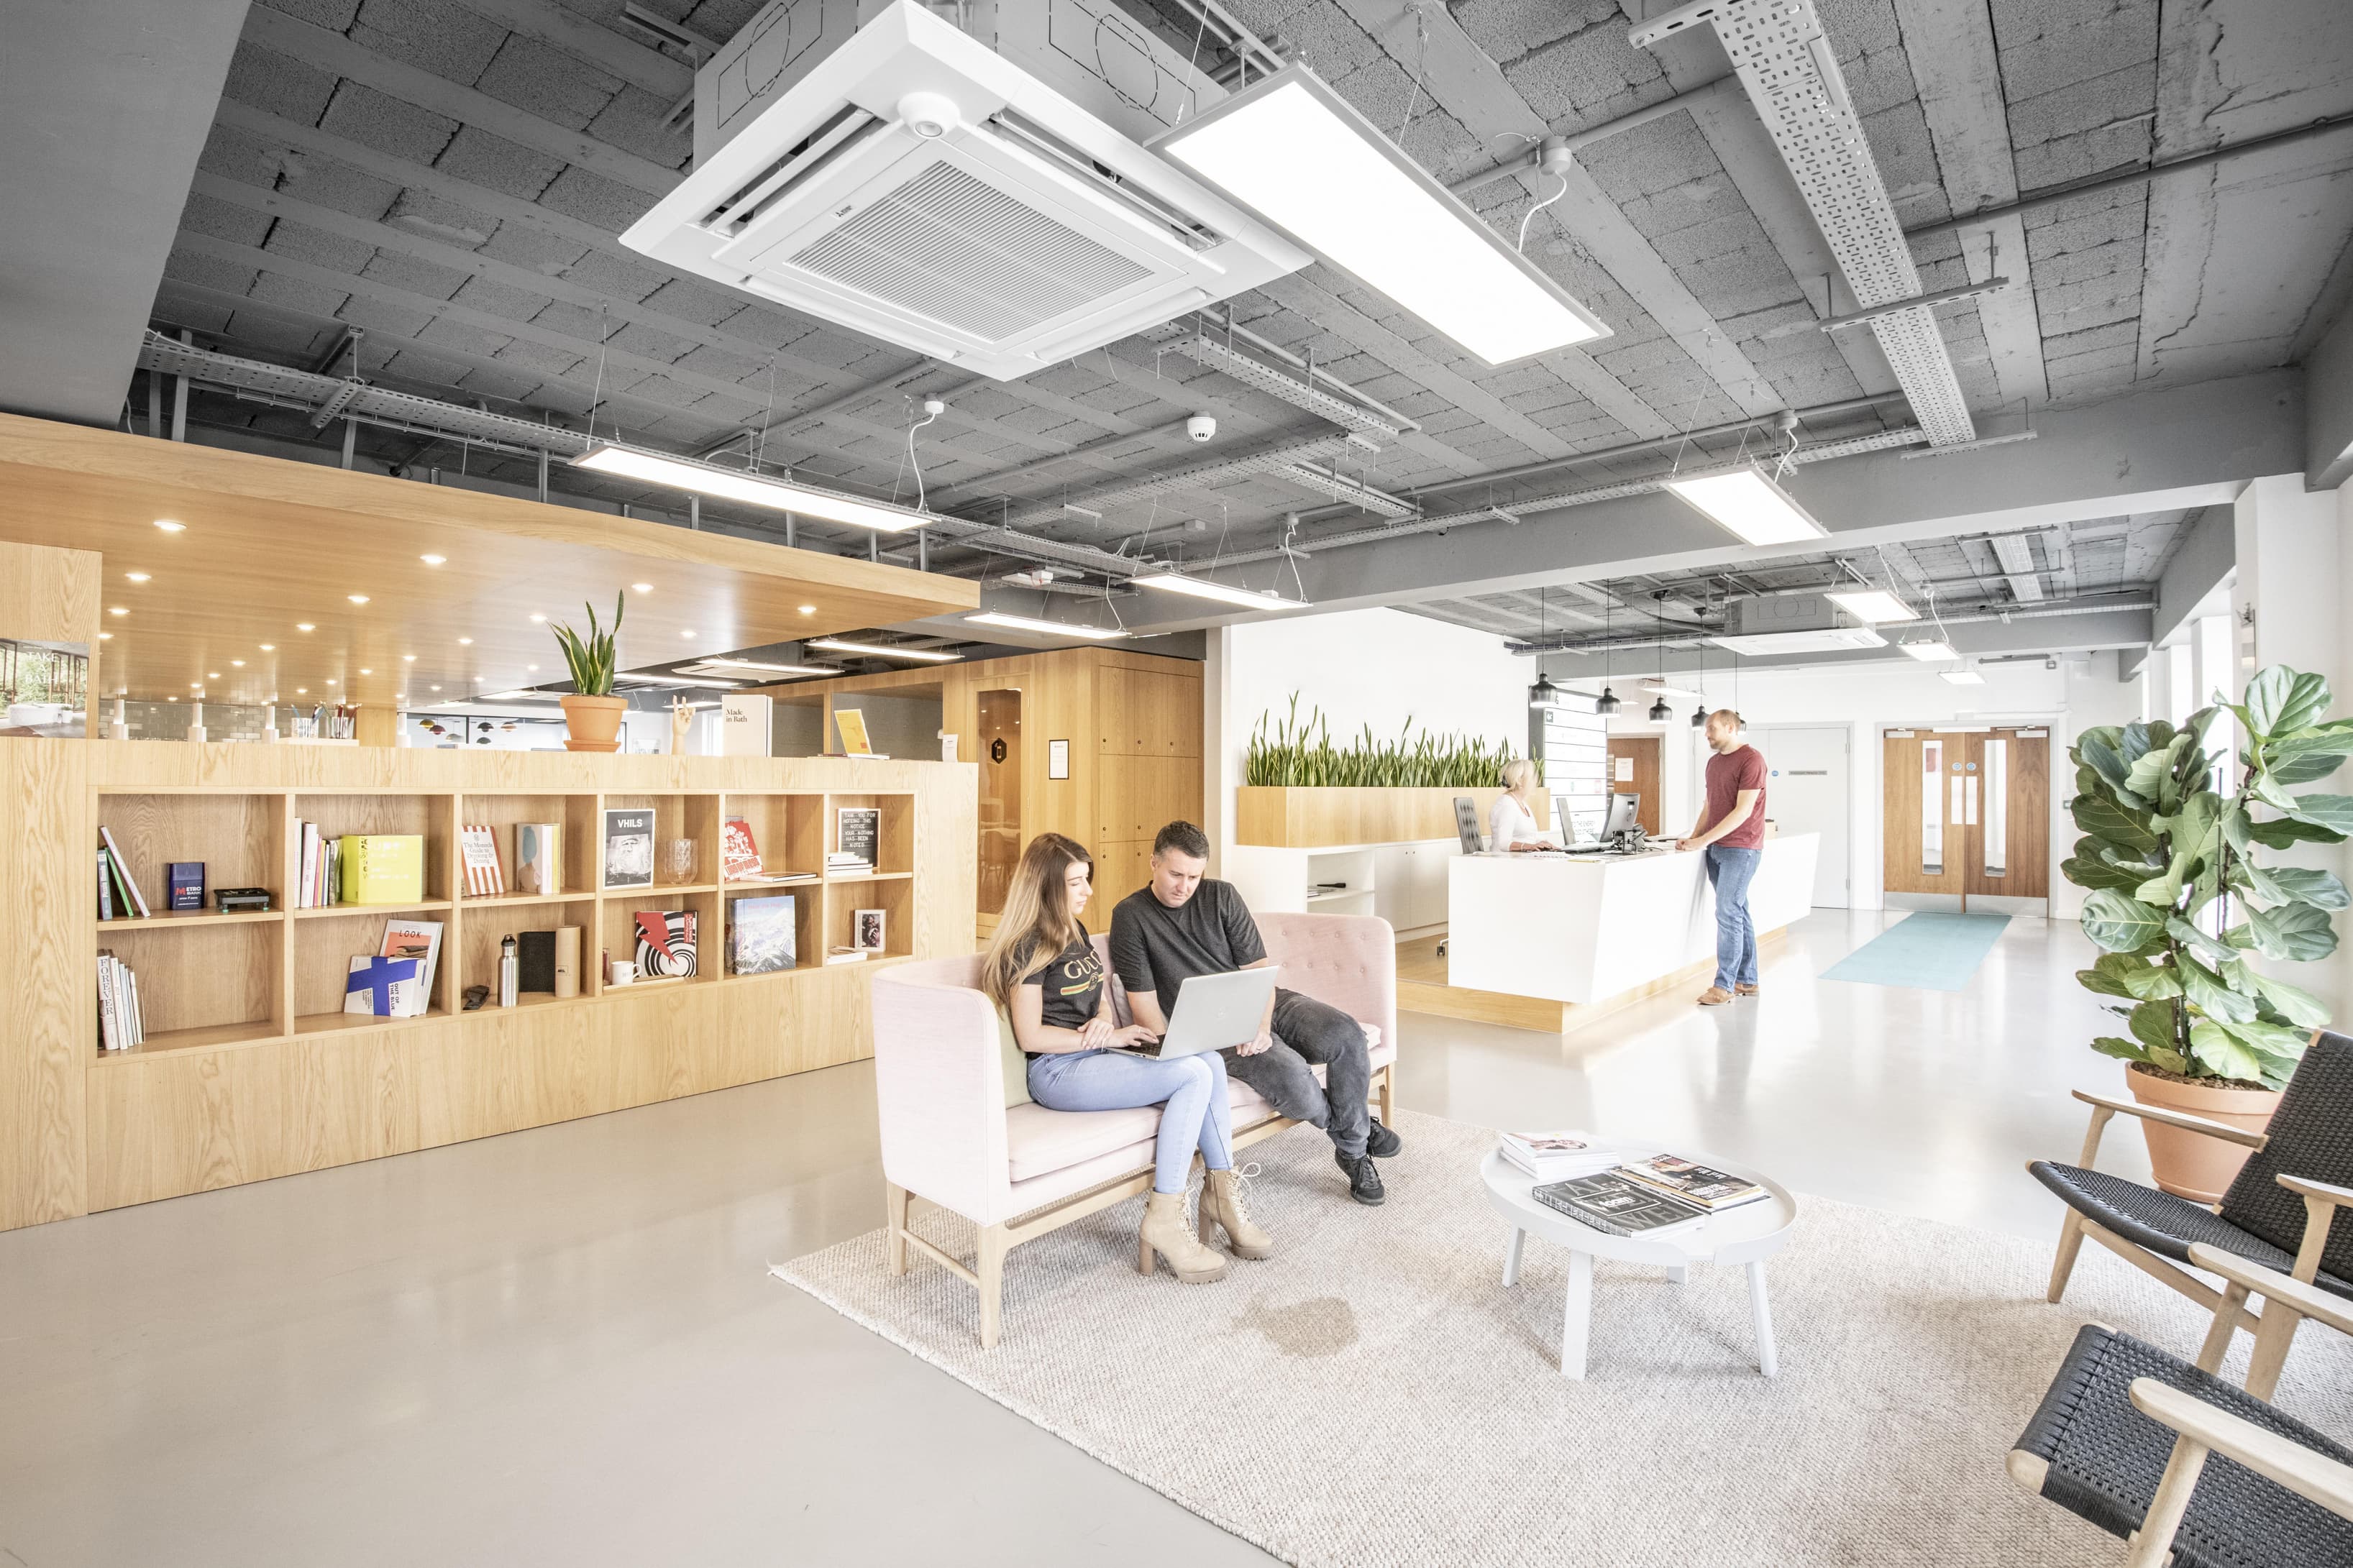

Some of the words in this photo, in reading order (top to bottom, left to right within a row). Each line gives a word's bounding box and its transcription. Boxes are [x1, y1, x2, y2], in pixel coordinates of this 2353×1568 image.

[29, 652, 60, 662] TAKE
[40, 664, 47, 673] A
[25, 675, 58, 684] BATH
[618, 819, 643, 828] VHILS
[175, 886, 202, 896] METRO
[399, 930, 421, 938] LOOK
[1064, 949, 1102, 978] GUCC
[100, 958, 114, 1015] FOREVER
